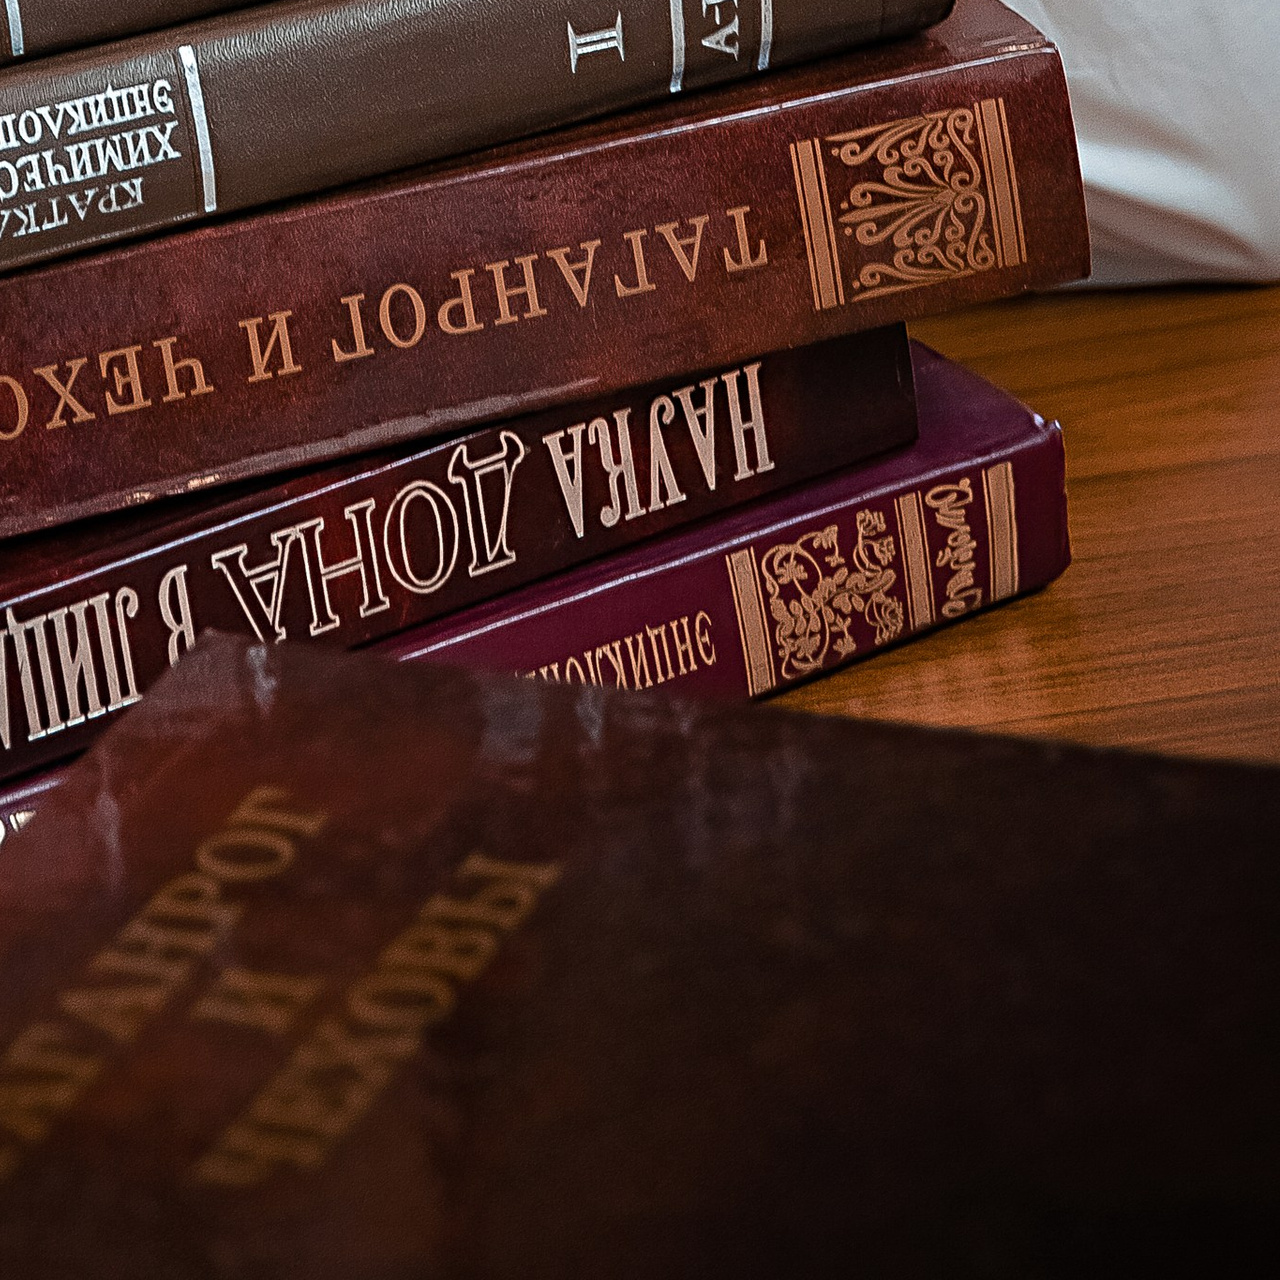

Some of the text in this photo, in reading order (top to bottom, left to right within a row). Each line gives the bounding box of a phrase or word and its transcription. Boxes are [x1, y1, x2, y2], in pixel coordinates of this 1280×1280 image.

[238, 308, 303, 384] И
[329, 205, 770, 366] ТАГАНРОГ
[542, 361, 776, 540] НАУКА
[212, 430, 530, 644] ДОНА
